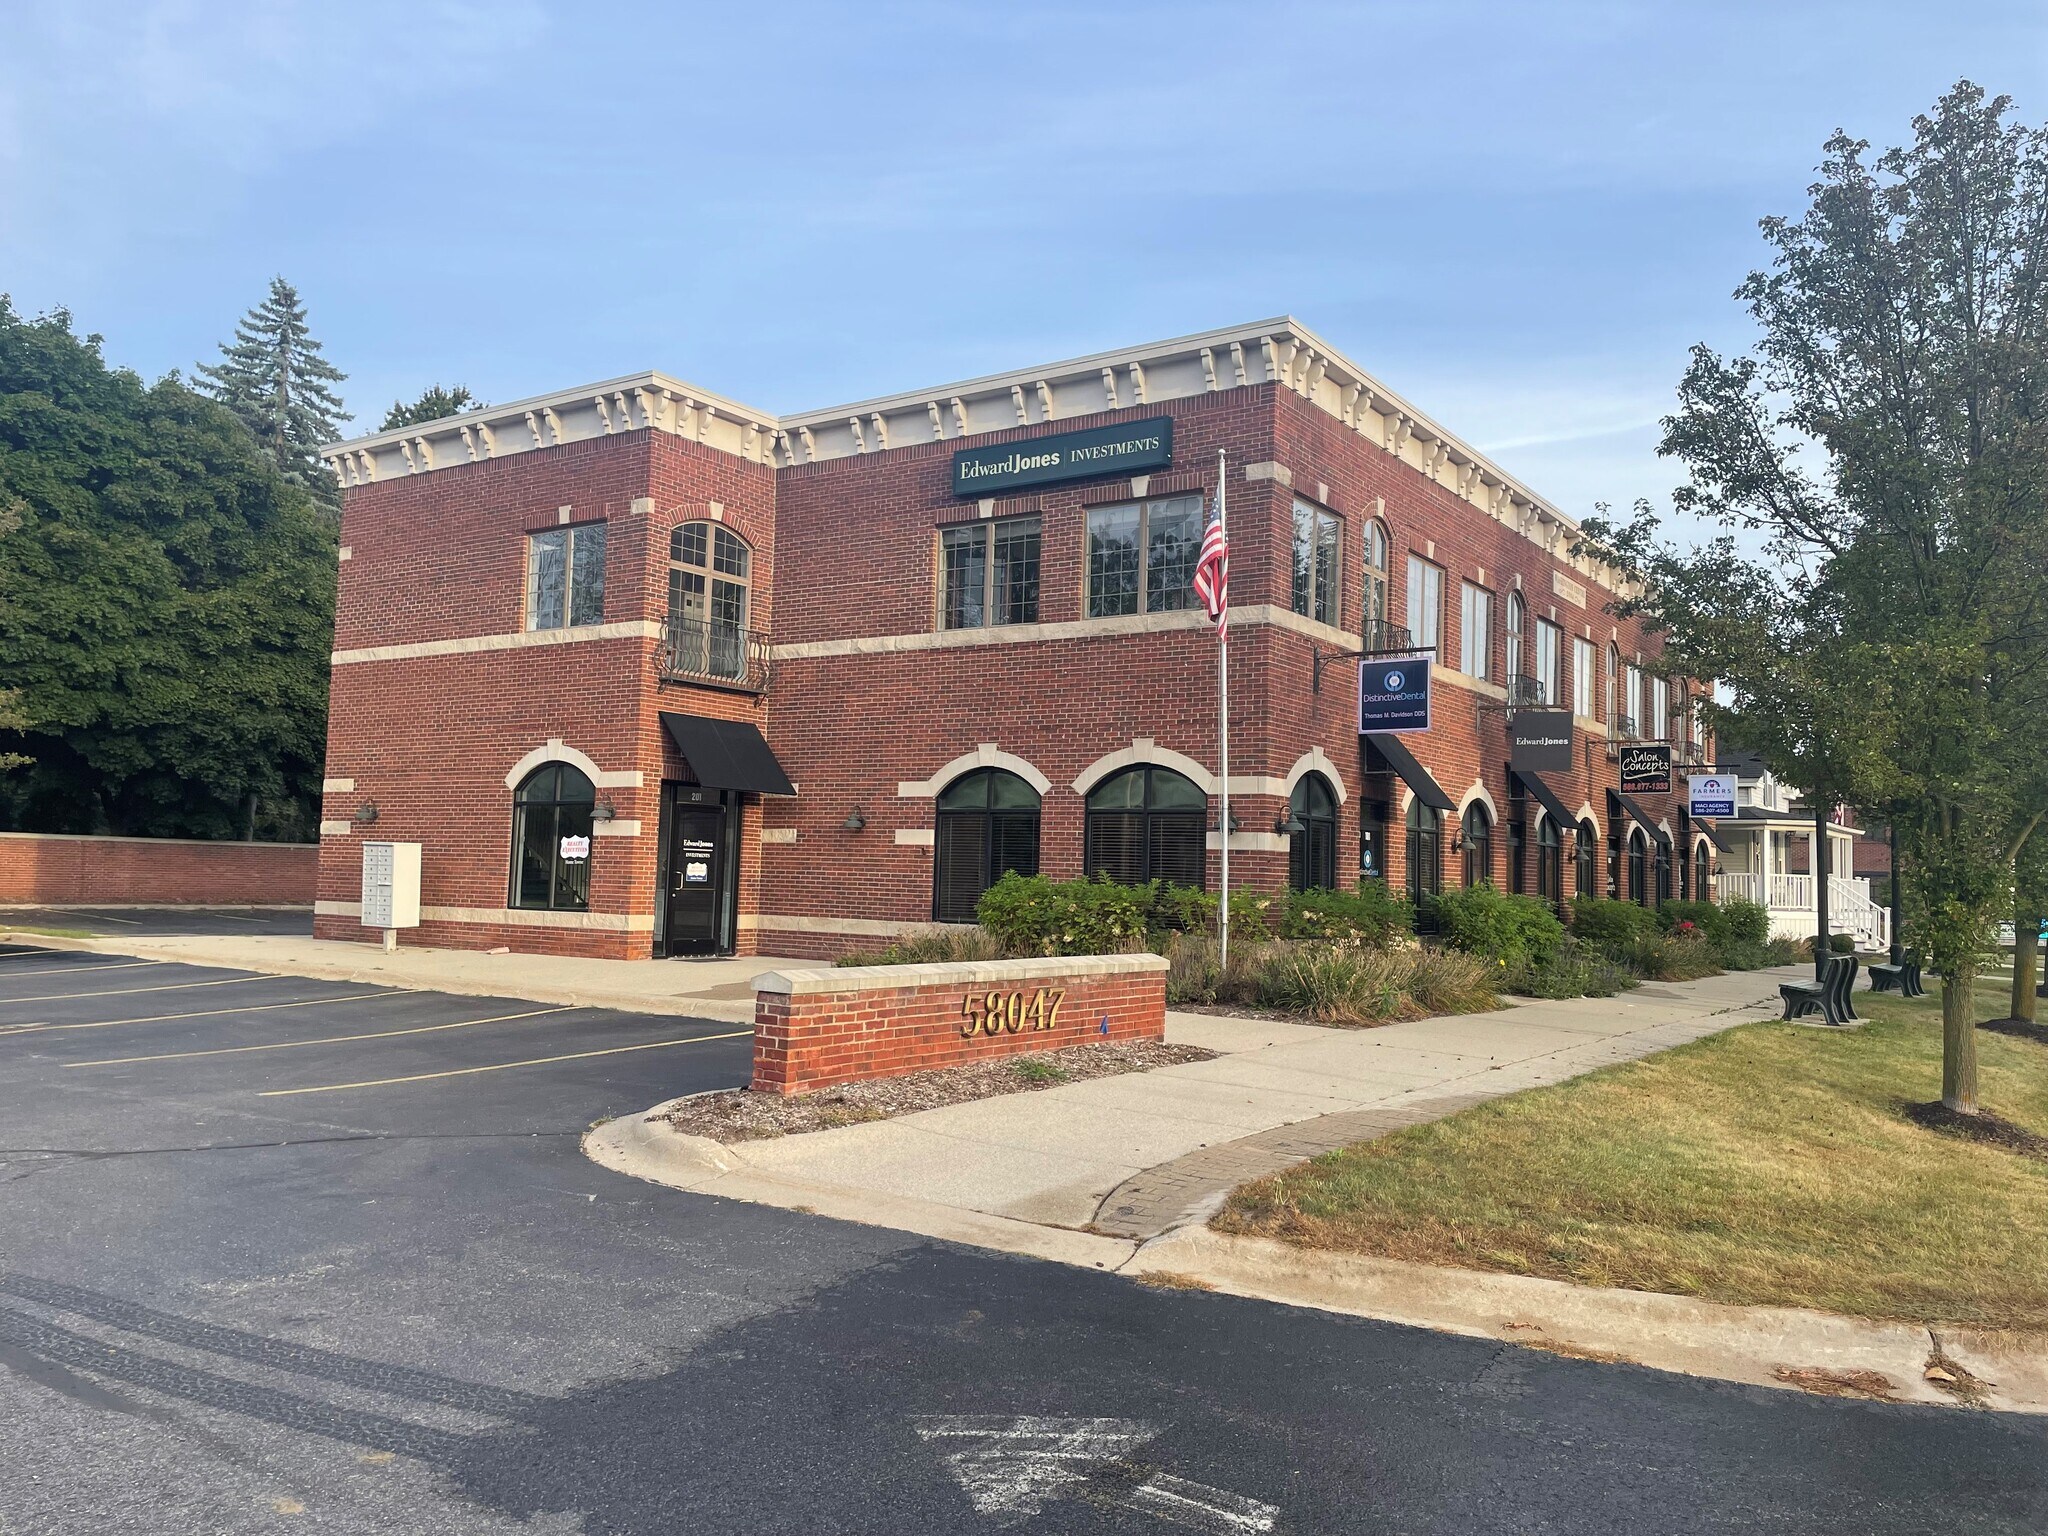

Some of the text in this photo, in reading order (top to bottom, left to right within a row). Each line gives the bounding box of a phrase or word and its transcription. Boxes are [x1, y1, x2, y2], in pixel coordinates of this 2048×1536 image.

[1071, 436, 1159, 462] INVESTMENTS
[1630, 750, 1659, 763] Salon
[1622, 758, 1669, 773] Concepts
[691, 793, 702, 801] 201
[960, 987, 1066, 1038] 58047
